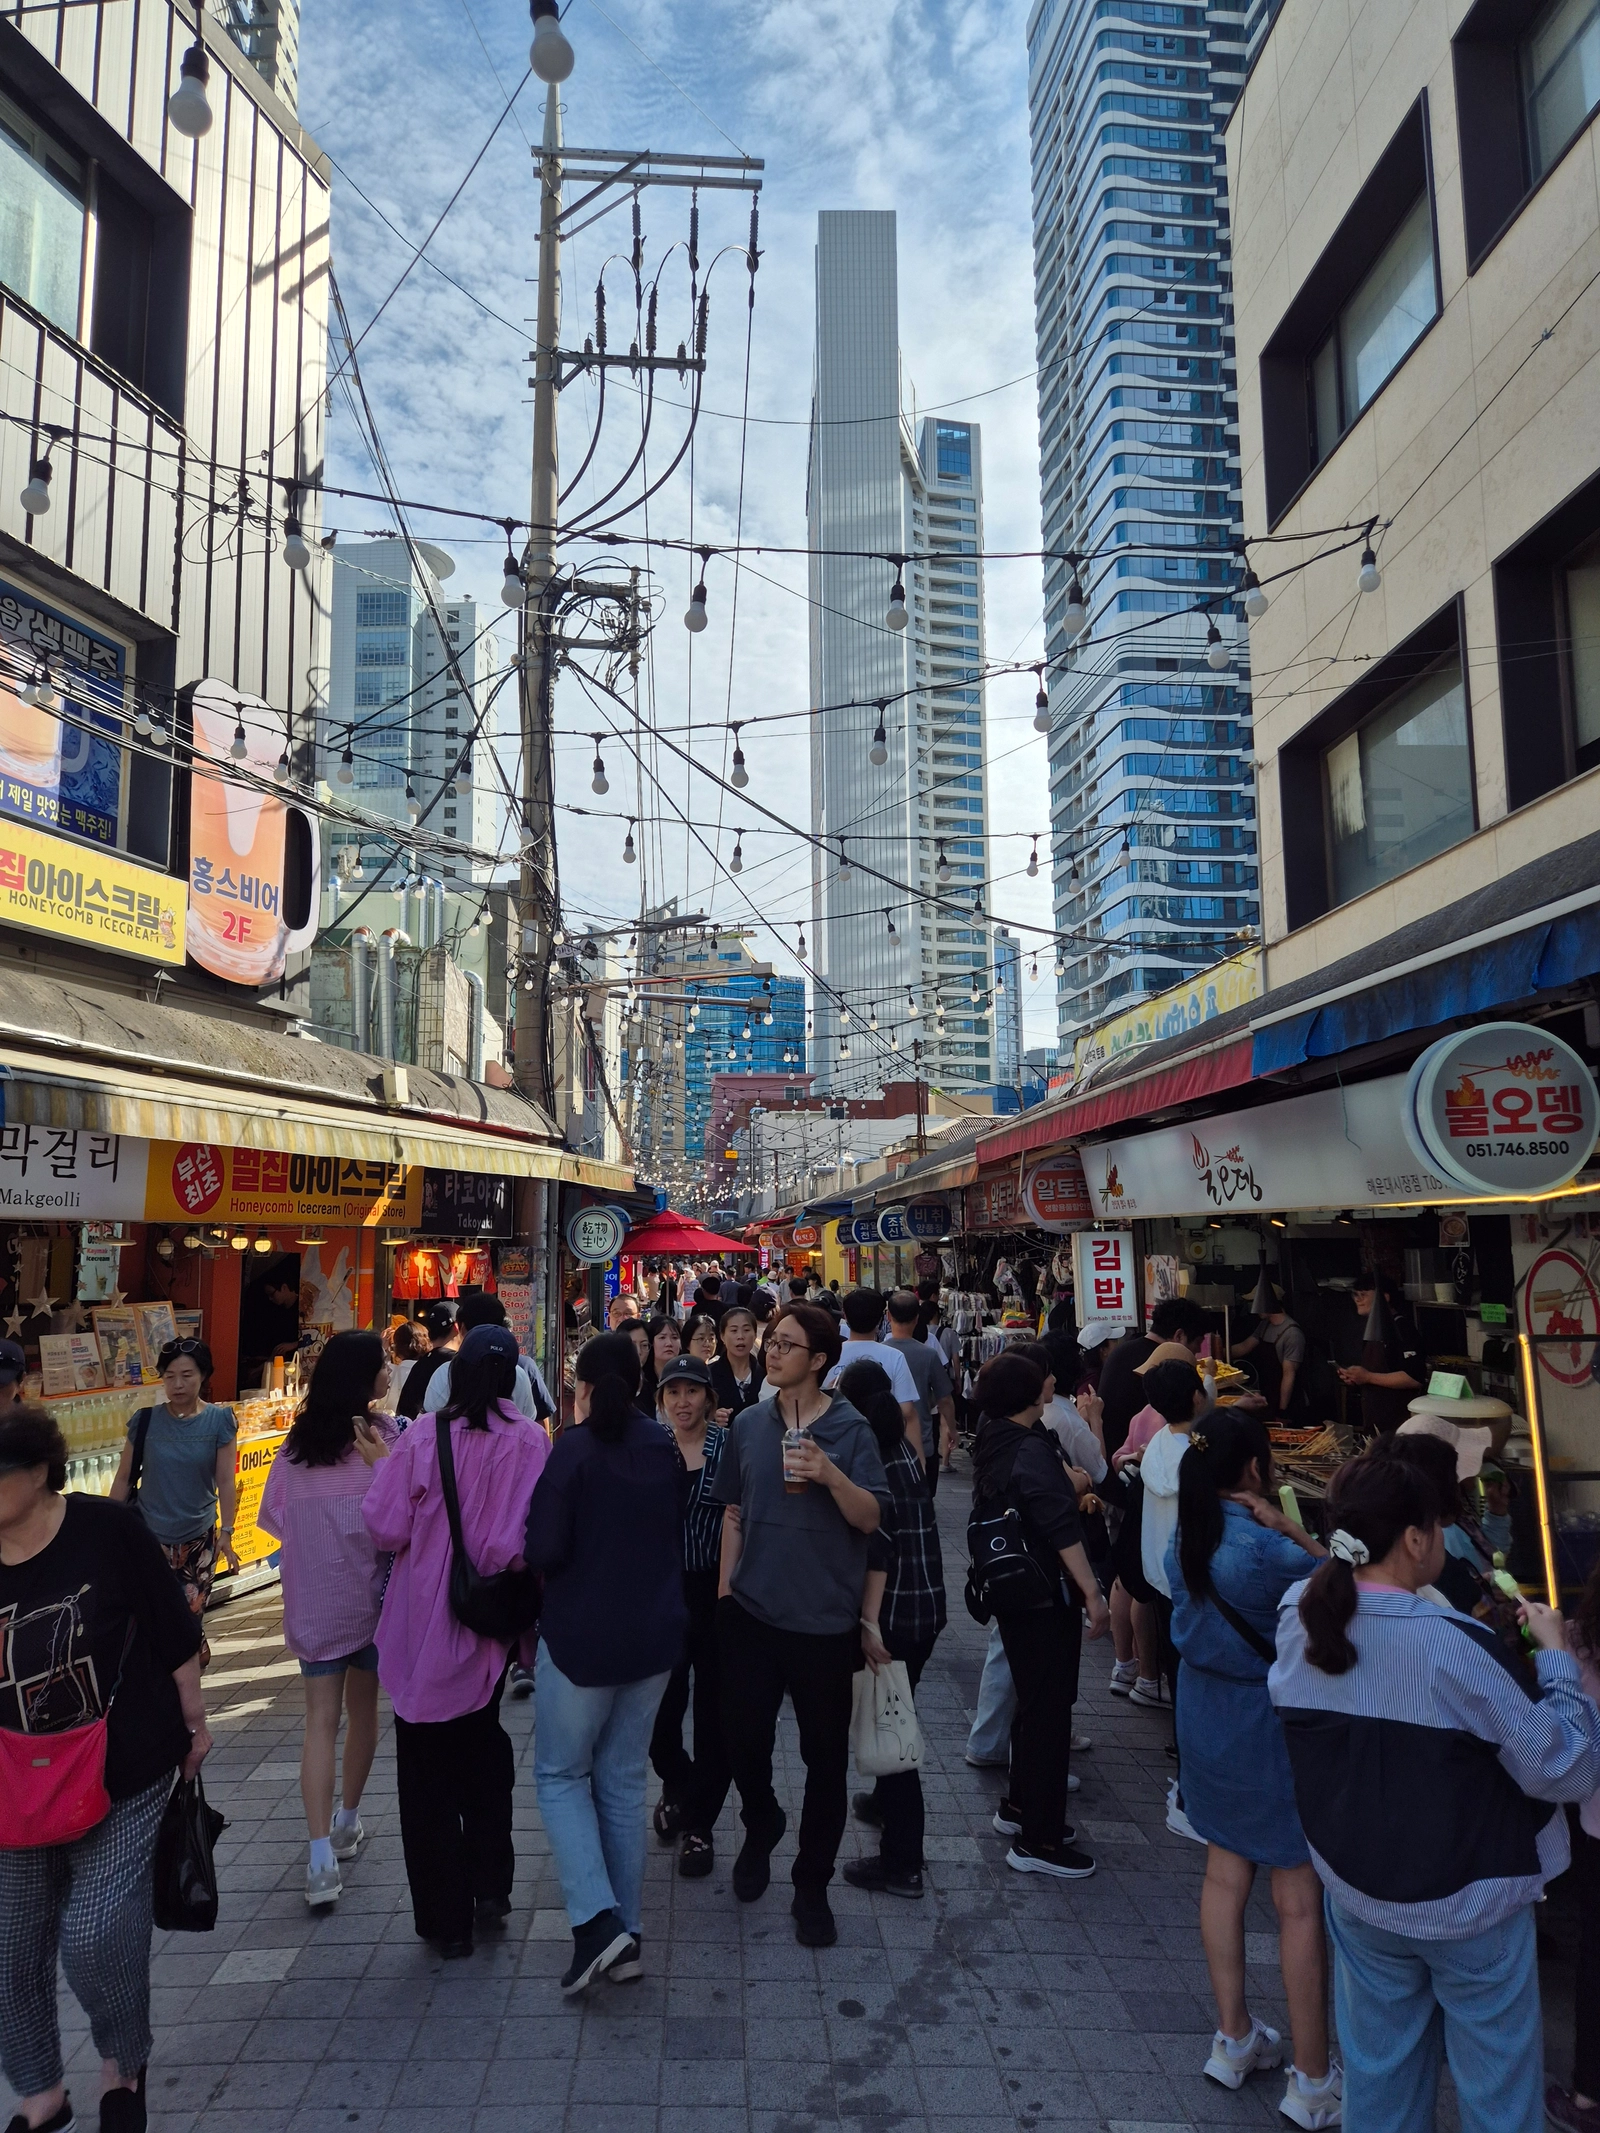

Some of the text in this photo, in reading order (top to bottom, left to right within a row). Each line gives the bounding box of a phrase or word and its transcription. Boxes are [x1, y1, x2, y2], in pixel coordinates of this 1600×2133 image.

[8, 782, 33, 812] 제일
[37, 790, 72, 826] 맛있는
[75, 809, 112, 840] 맥주집!
[192, 856, 280, 917] 홍스비어
[9, 889, 160, 944] HONEYCOMB ICECREAM
[221, 910, 253, 944] 2F
[1445, 1085, 1584, 1138] 불오뎅
[0, 1124, 121, 1184] 막걸리
[176, 1144, 213, 1183] 부산
[1466, 1140, 1570, 1158] 051.746.8500
[0, 1188, 81, 1209] Makgeolli
[184, 1170, 221, 1210] 최초
[230, 1197, 407, 1219] Honeycomb Icecream (Original Store)
[458, 1212, 493, 1230] Takoyaki
[916, 1223, 944, 1235] 양품점
[1092, 1239, 1125, 1310] 김밥
[501, 1290, 529, 1298] Beach
[504, 1300, 526, 1309] Stay
